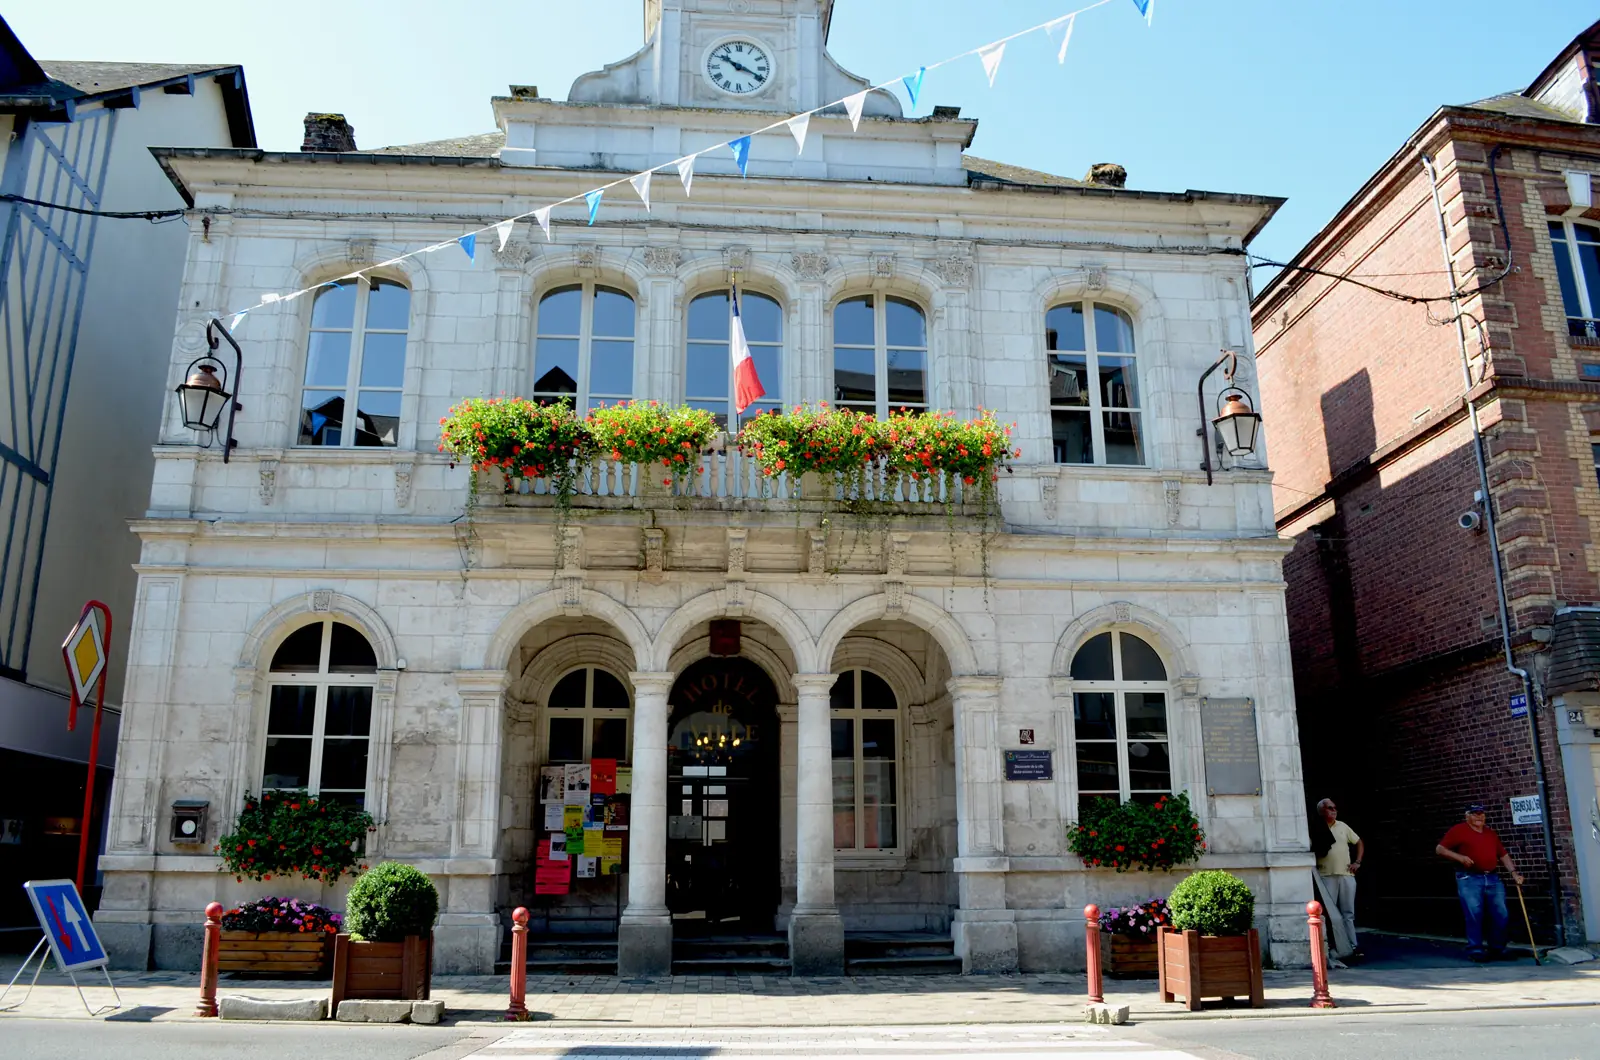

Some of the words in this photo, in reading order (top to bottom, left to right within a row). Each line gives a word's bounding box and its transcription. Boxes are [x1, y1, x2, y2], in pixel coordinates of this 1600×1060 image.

[712, 698, 733, 716] de
[1569, 712, 1582, 722] 24
[691, 724, 759, 741] VILLE
